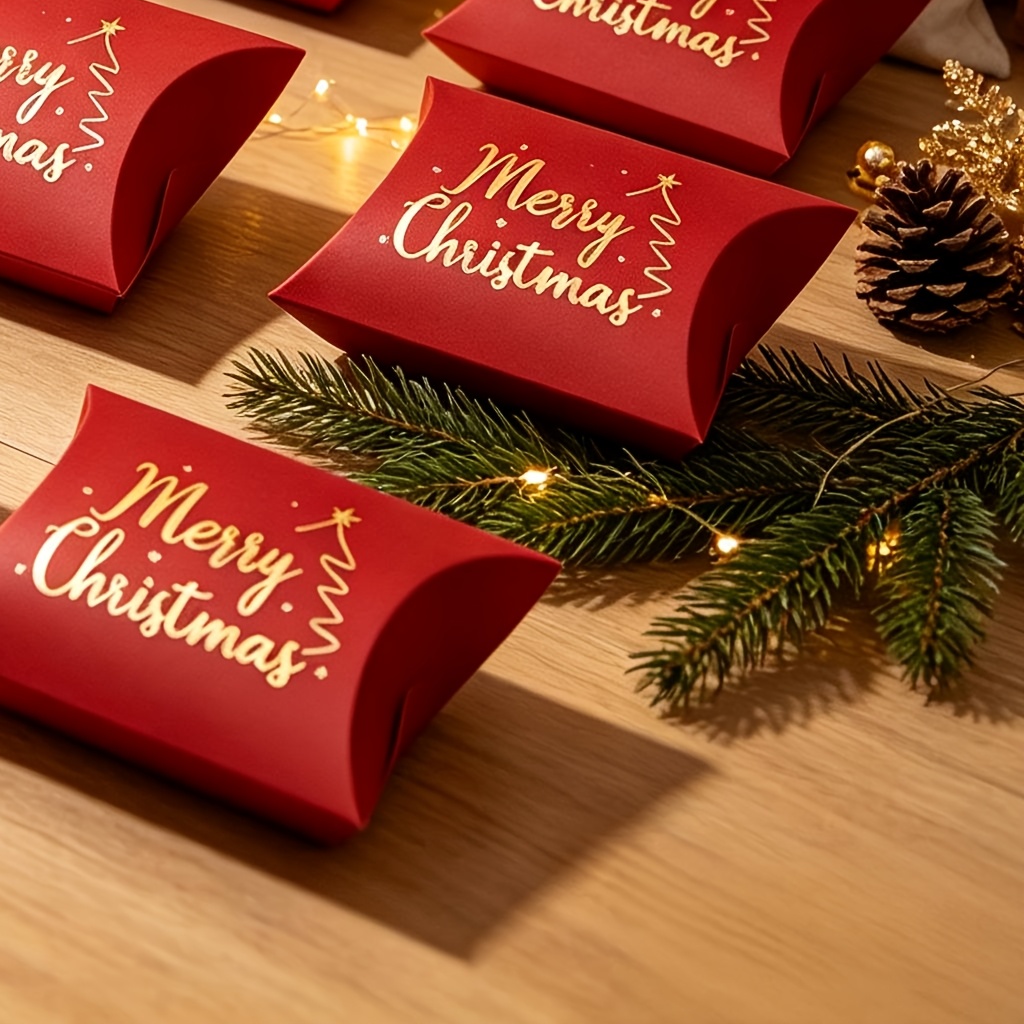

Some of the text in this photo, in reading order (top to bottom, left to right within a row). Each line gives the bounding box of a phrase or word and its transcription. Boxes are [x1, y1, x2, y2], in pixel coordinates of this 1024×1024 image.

[393, 193, 643, 326] Christmas
[440, 143, 635, 268] Merry
[32, 516, 307, 688] Christmas
[89, 462, 304, 616] Merry
